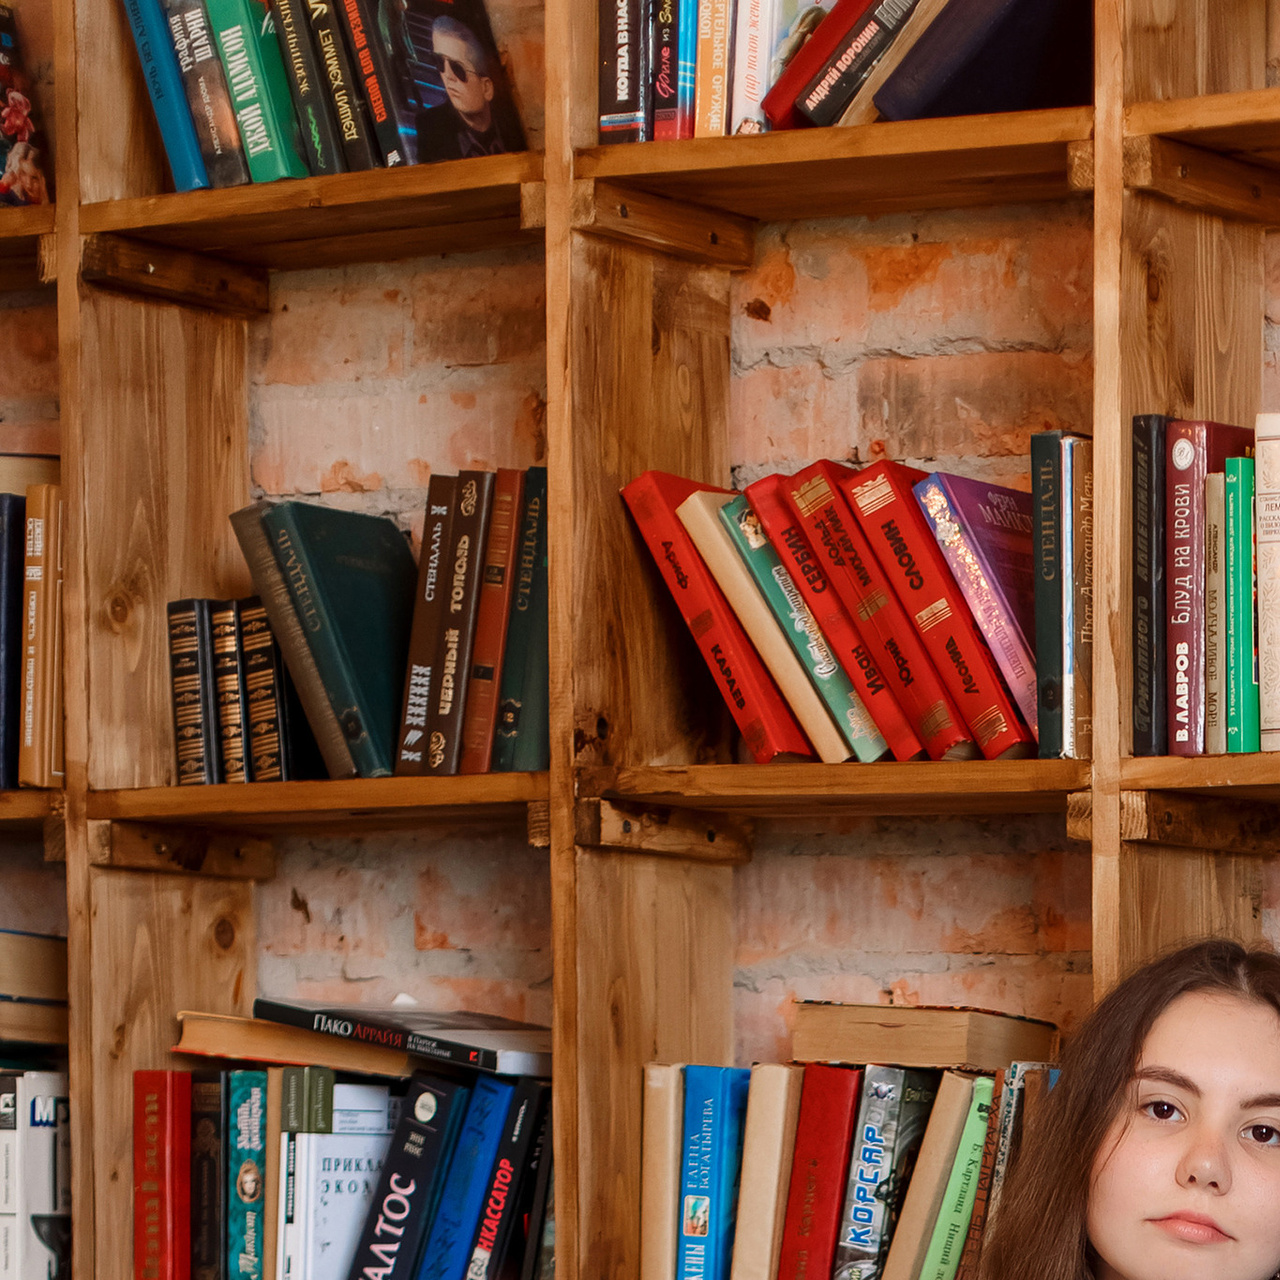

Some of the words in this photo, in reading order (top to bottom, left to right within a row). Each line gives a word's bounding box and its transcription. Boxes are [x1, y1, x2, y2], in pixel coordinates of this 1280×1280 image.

[170, 14, 193, 73] графиня
[184, 7, 213, 62] ШАРНИ
[220, 24, 258, 101] АДАМСОН
[319, 29, 345, 92] ХЭММЕТ
[805, 69, 842, 111] АНДРЕЙ
[835, 20, 880, 73] ВОРОНИН
[199, 76, 211, 103] ДЮМА
[334, 89, 359, 141] ДЭШИЛ
[205, 101, 222, 155] АЛЕКСАНДР
[238, 102, 273, 158] ДЖОЙ
[823, 504, 873, 588] МИХАЙЛИК
[1040, 459, 1056, 582] СТЕНДАЛЬ
[278, 529, 321, 632] СТЕНДАЛЬ
[425, 522, 443, 601] СТЕНДАЛЬ
[450, 534, 471, 613] ТОПОЛЬ
[516, 496, 541, 612] СТЕНДАЛЬ
[780, 525, 828, 594] СЕРБИН
[881, 519, 925, 590] СЛОВИН
[661, 540, 689, 590] Ариф
[710, 643, 747, 711] КАРАЕВ
[1207, 589, 1218, 681] МОЛЧАЛИВОЕ
[851, 646, 886, 696] Иван
[885, 636, 915, 688] Юрий
[945, 635, 980, 695] Леонид
[1208, 691, 1218, 727] МОРЕ
[313, 1013, 351, 1036] ПАКО
[352, 1023, 402, 1048] АРРАЙЯ
[971, 1142, 983, 1154] Б.
[849, 1124, 886, 1246] КОРСАР
[953, 1157, 980, 1214] Картланд
[943, 1223, 961, 1266] Нищий
